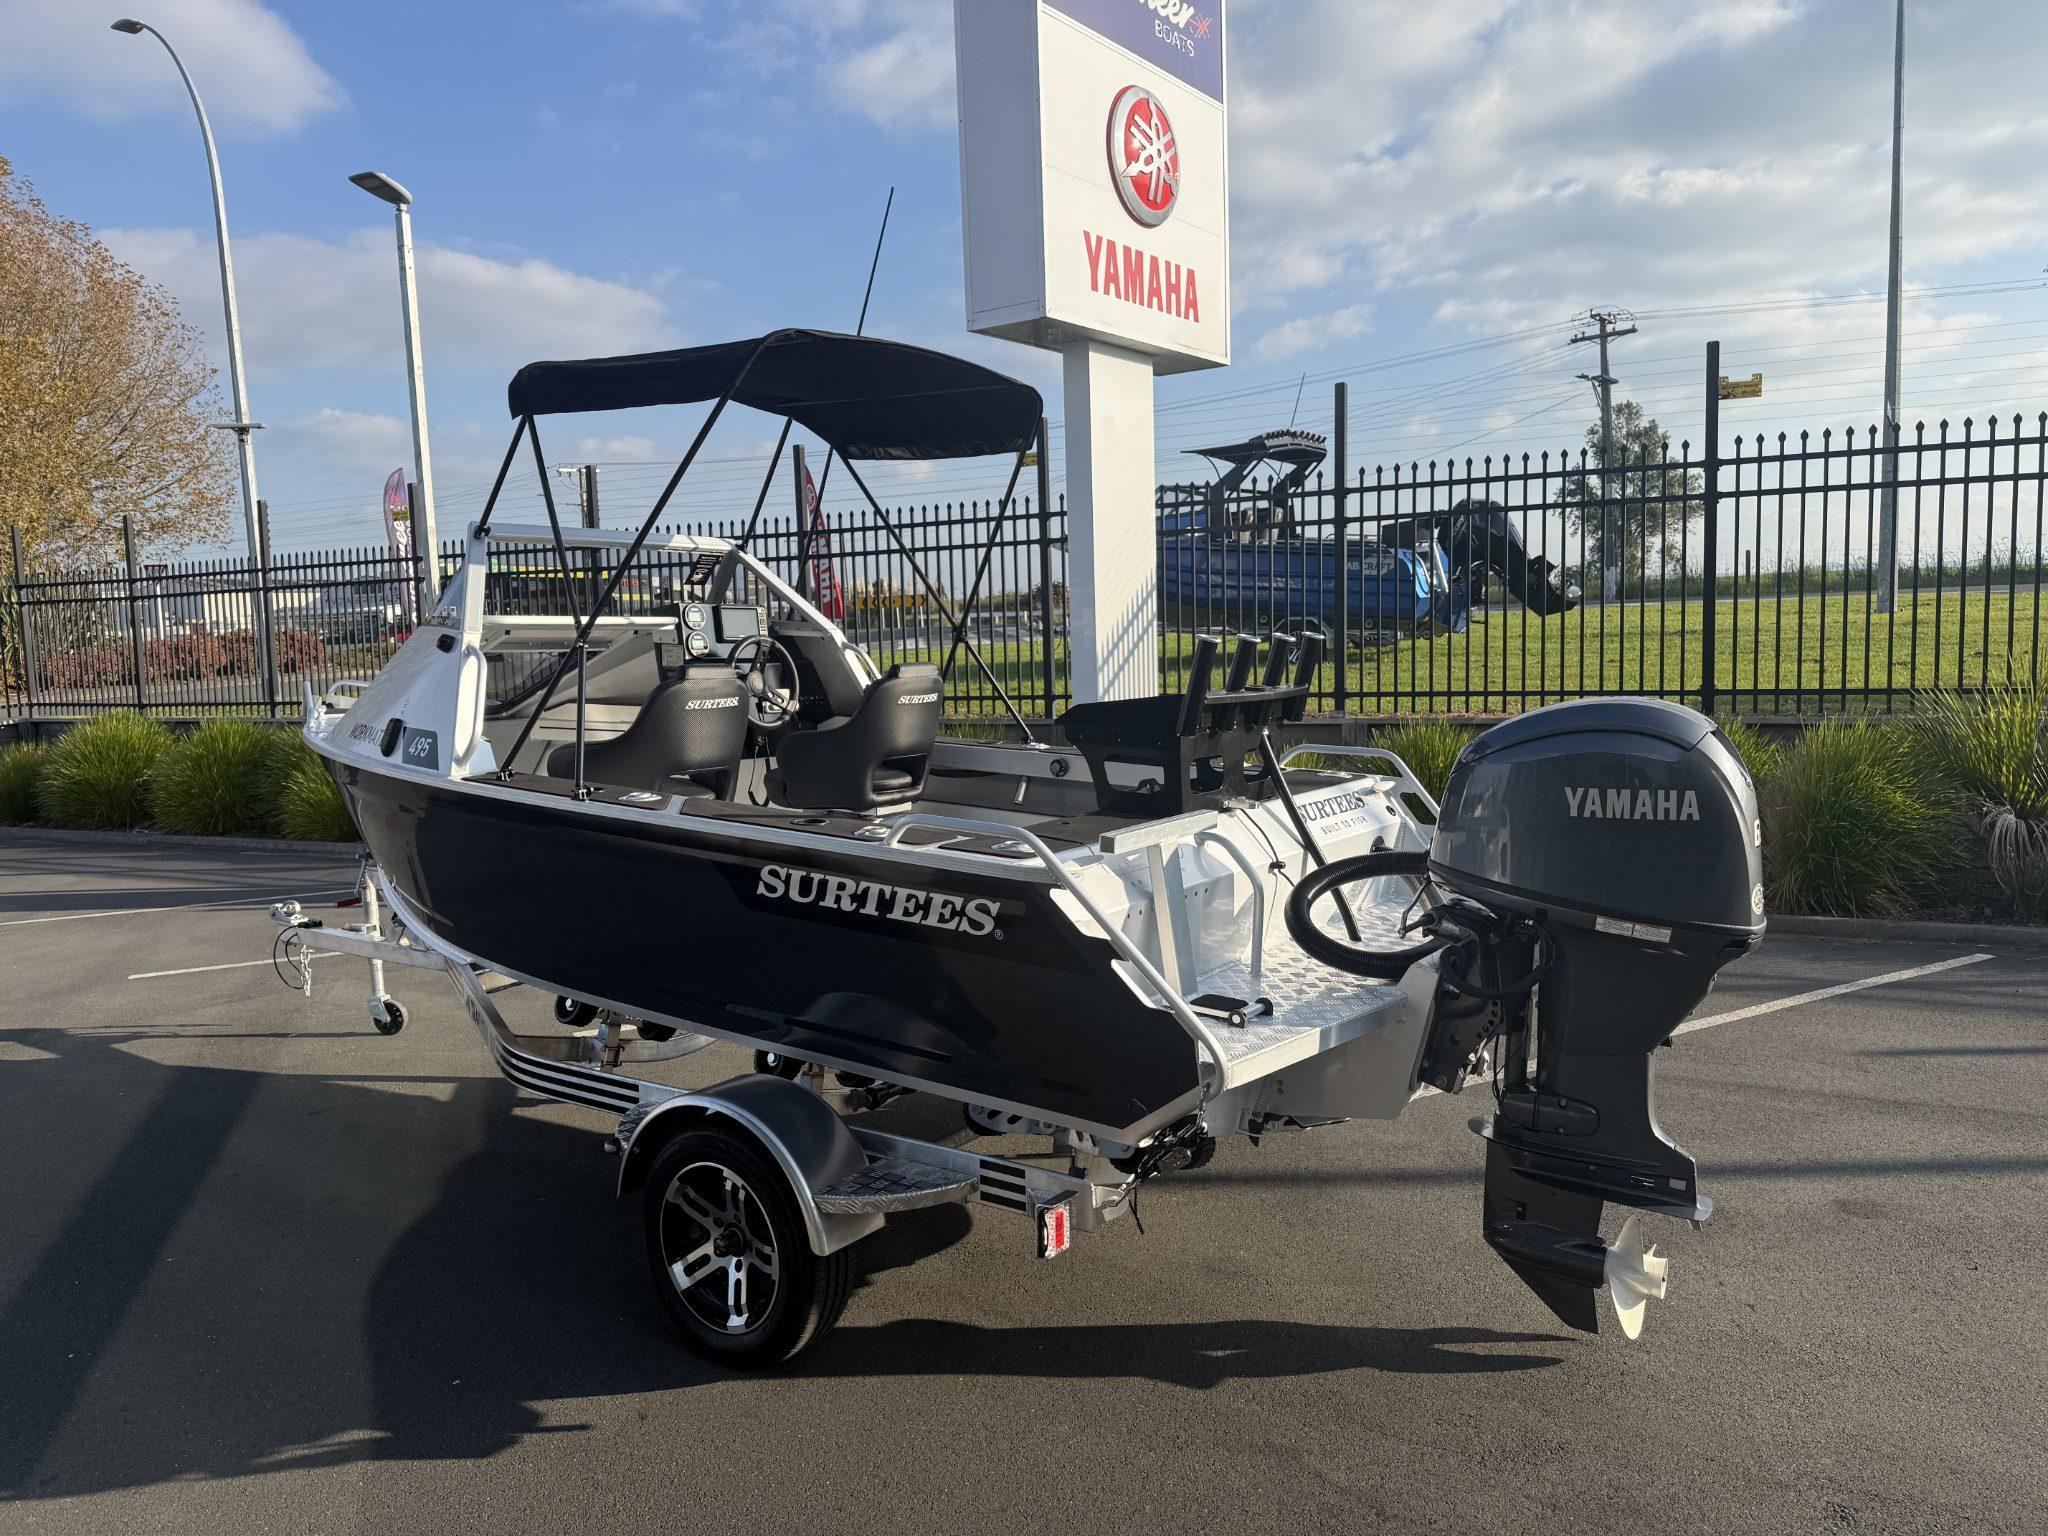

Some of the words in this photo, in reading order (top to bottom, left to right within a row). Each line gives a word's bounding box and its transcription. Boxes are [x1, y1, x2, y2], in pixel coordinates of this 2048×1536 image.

[1155, 19, 1195, 57] BOATS
[1083, 229, 1200, 323] YAMAHA
[684, 696, 740, 710] SURTEES
[898, 692, 939, 704] SURTEES
[350, 722, 385, 747] WORKMAT
[408, 736, 433, 757] 495
[1564, 786, 1700, 821] YAMAHA
[1321, 822, 1341, 835] BUILT
[1341, 820, 1351, 829] TO
[1351, 815, 1369, 827] FISH
